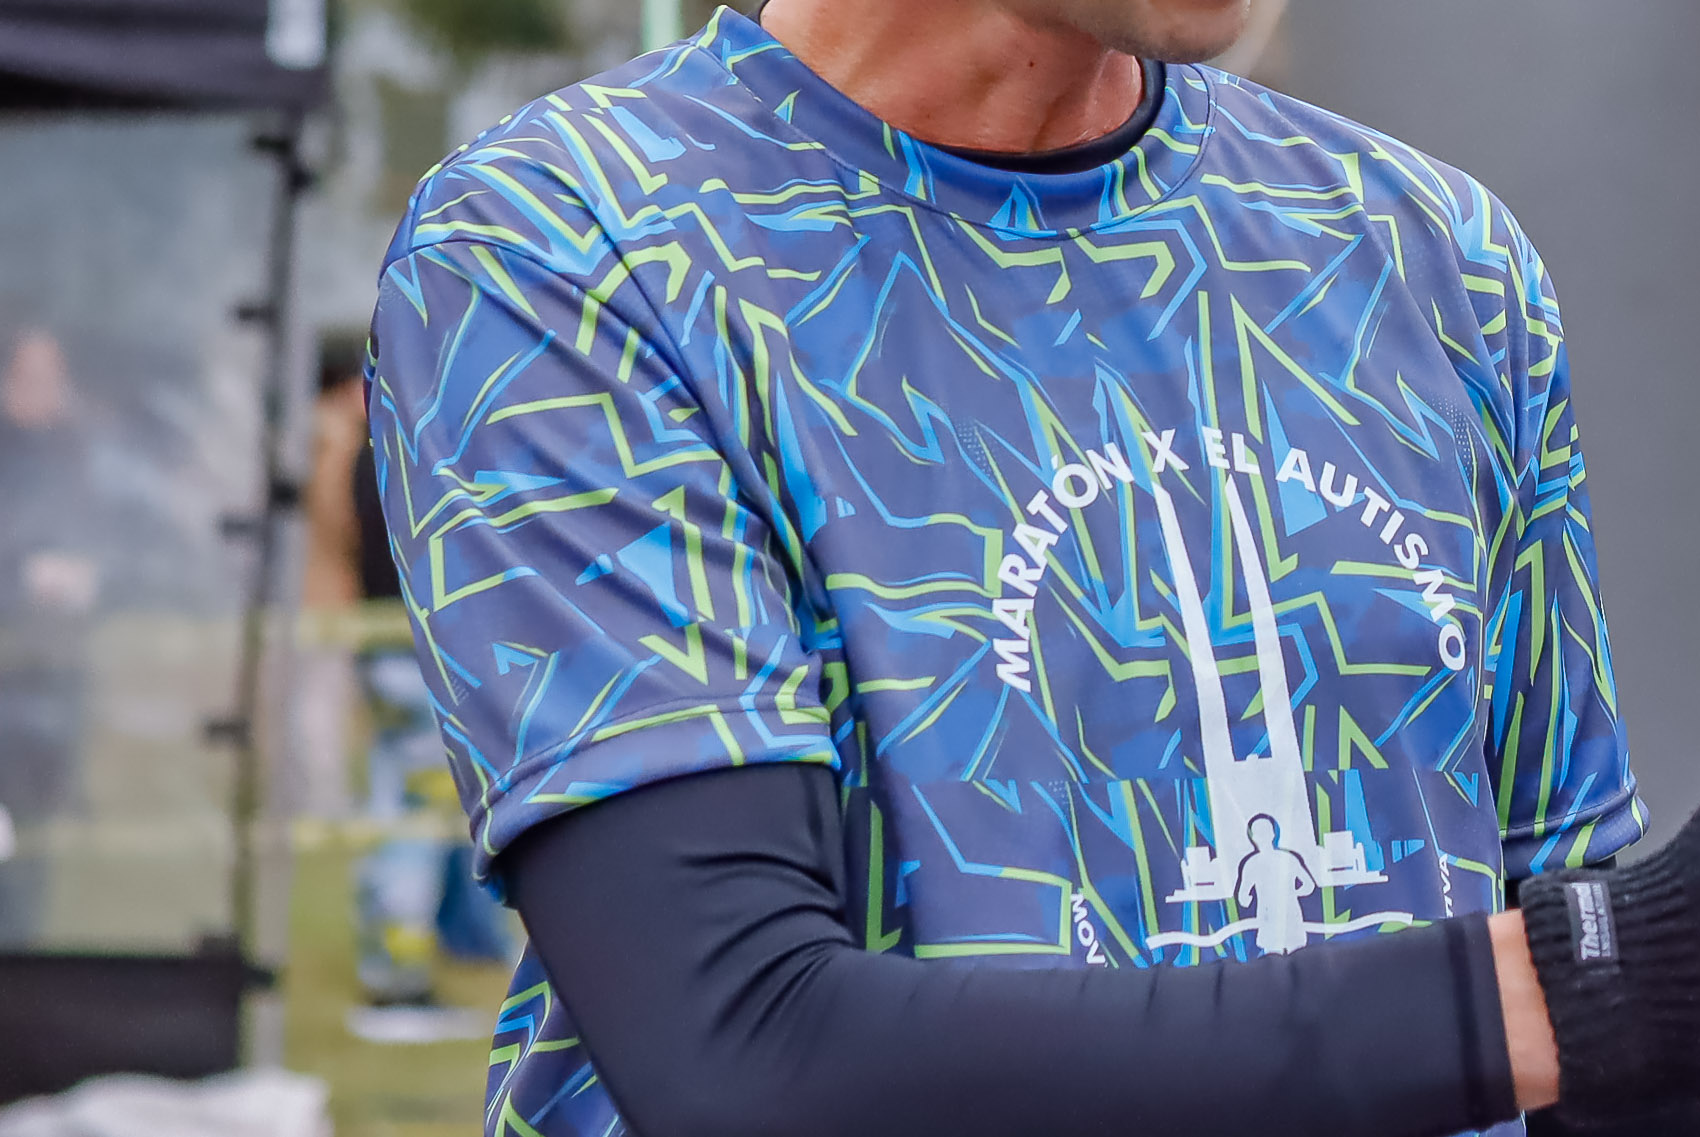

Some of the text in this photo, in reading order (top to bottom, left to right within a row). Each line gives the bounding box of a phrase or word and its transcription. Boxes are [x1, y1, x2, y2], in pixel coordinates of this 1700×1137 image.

[992, 426, 1466, 692] MARATÓN X EL AUTISMO
[1070, 893, 1108, 968] MOV
